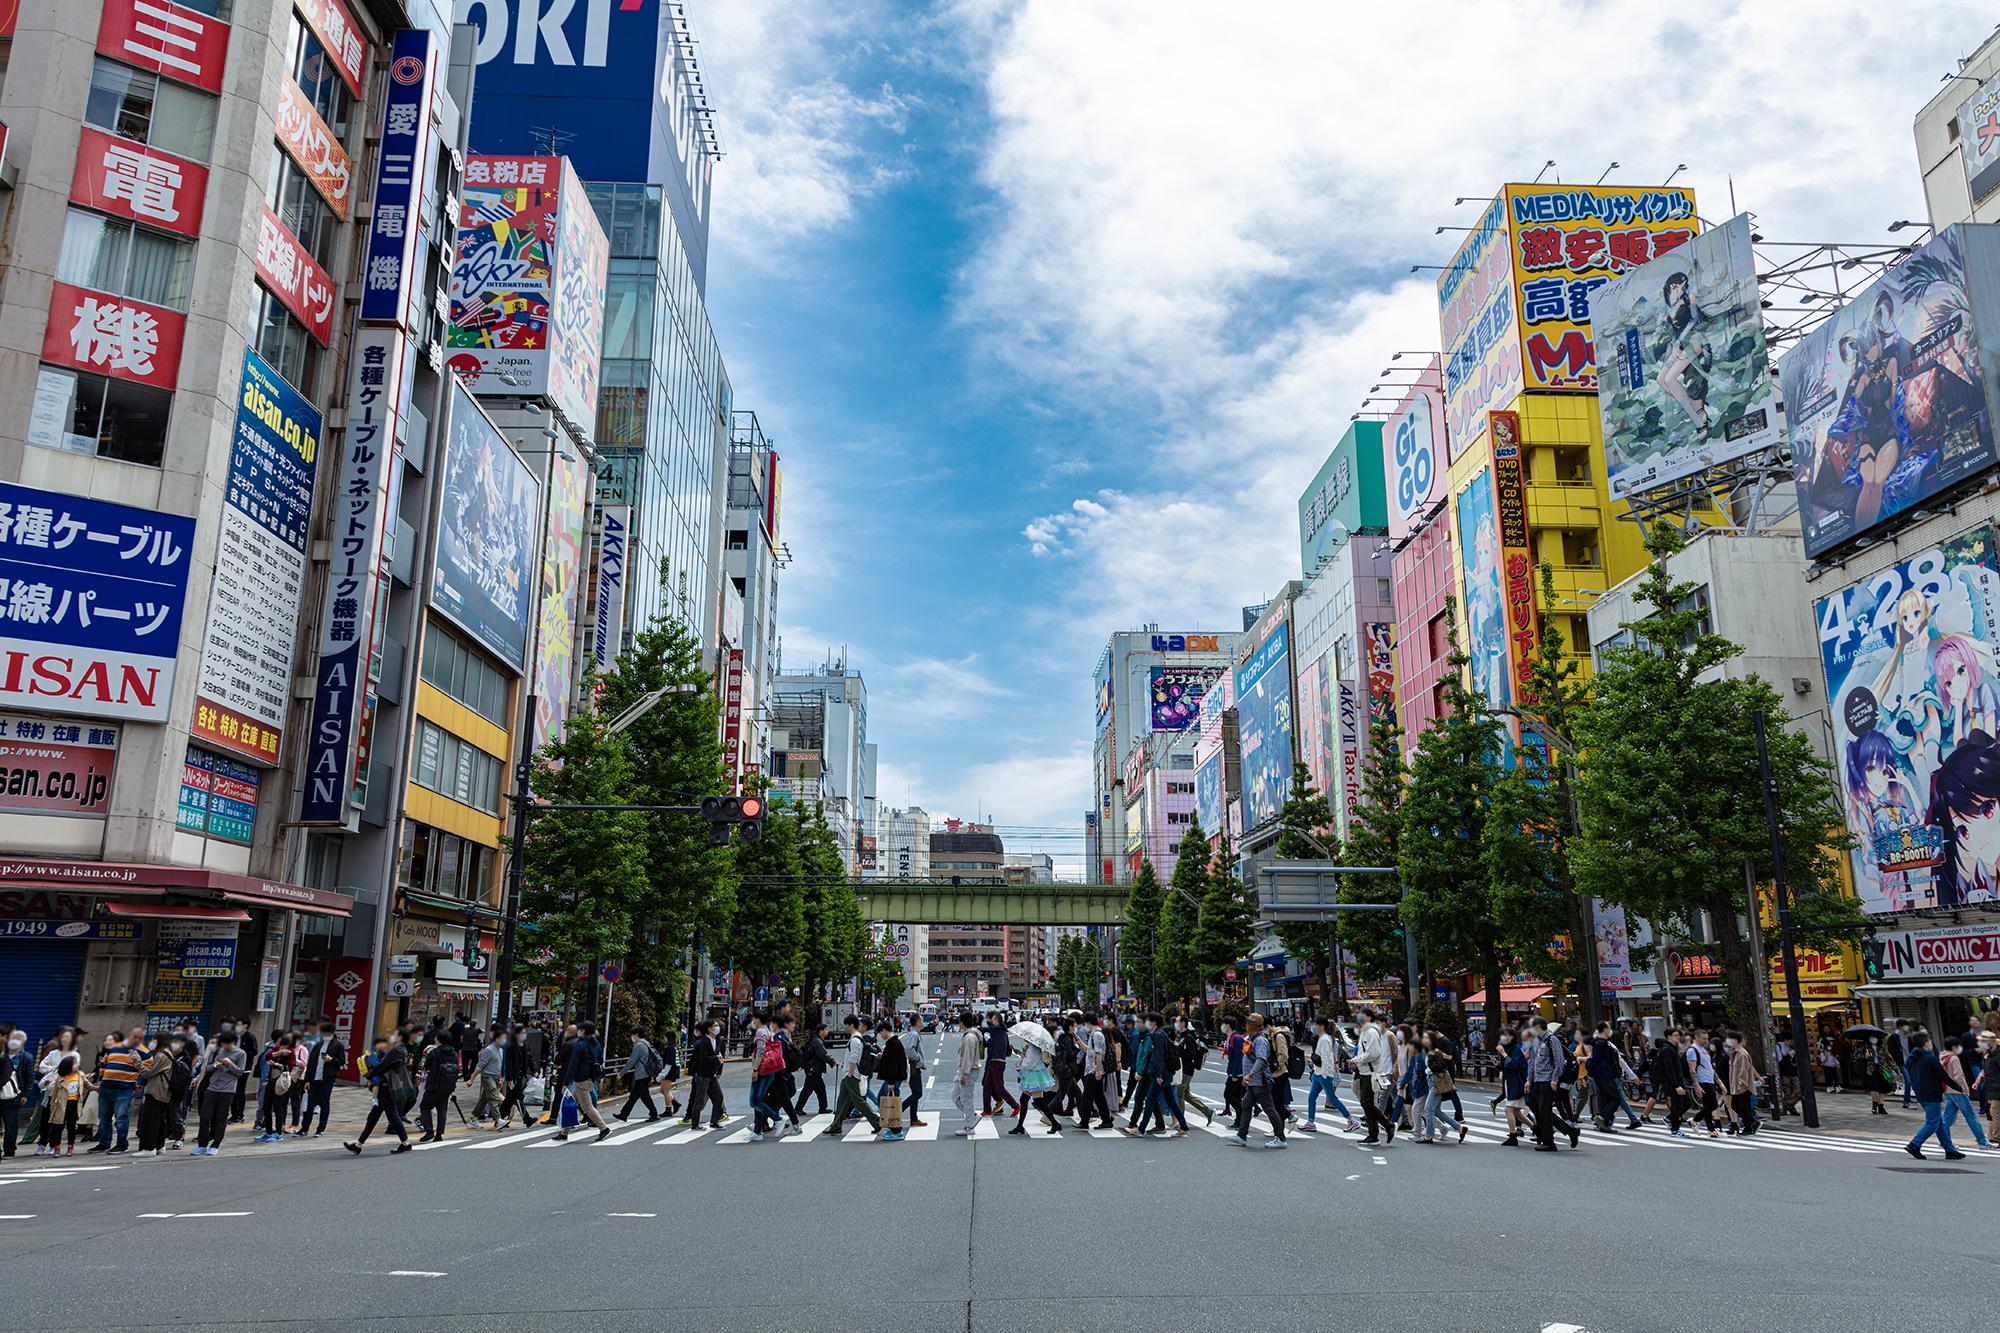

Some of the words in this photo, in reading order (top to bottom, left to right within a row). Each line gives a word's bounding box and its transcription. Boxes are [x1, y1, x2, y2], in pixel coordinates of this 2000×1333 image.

[277, 90, 350, 201] ネットワーク
[103, 144, 183, 223] 電
[466, 162, 548, 187] 免税店
[369, 103, 418, 292] 愛三電機
[1515, 191, 1693, 226] MEDIAリサイクル
[260, 224, 334, 325] 配線パーツ
[486, 281, 545, 291] INTERNATIONAL
[71, 297, 160, 377] 機
[1914, 320, 1960, 355] カーネリアン
[498, 357, 533, 370] Japan.
[1629, 336, 1641, 382] ブラックナイト
[493, 370, 533, 379] Tax-free
[243, 380, 316, 465] aisan.co.jp
[594, 464, 623, 485] 4h
[1498, 459, 1518, 469] DVD
[1498, 470, 1520, 479] ブルーレイ
[331, 345, 386, 643] 各種ケーブル・ネットワーク機器
[595, 487, 622, 499] PEN
[1499, 480, 1520, 489] ゲーム
[1503, 489, 1516, 498] CD
[1501, 498, 1522, 507] アイドル
[1501, 508, 1523, 517] アニメ
[1503, 518, 1523, 527] コミック
[1504, 528, 1523, 537] ホビー
[604, 514, 627, 590] AKKY
[1504, 538, 1525, 547] フィギュア
[1833, 655, 1846, 665] FRI
[1852, 648, 1864, 658] ON
[1866, 638, 1888, 654] SALE
[1339, 684, 1355, 733] AKKY
[17, 722, 45, 742] 特約
[52, 726, 81, 745] 在庫
[87, 730, 116, 747] 直販
[197, 705, 217, 731] 各社
[219, 713, 239, 741] 特約
[240, 721, 259, 748] 在庫
[260, 729, 279, 755] 直販
[311, 664, 348, 805] AISAN
[5, 921, 48, 936] 1949
[417, 925, 438, 940] MOCO
[1942, 928, 1963, 938] Support
[1971, 924, 1998, 936] Magazine
[187, 944, 233, 958] aisan.co.jp
[1919, 939, 1983, 963] COMIC
[1920, 963, 1975, 975] Akihabara
